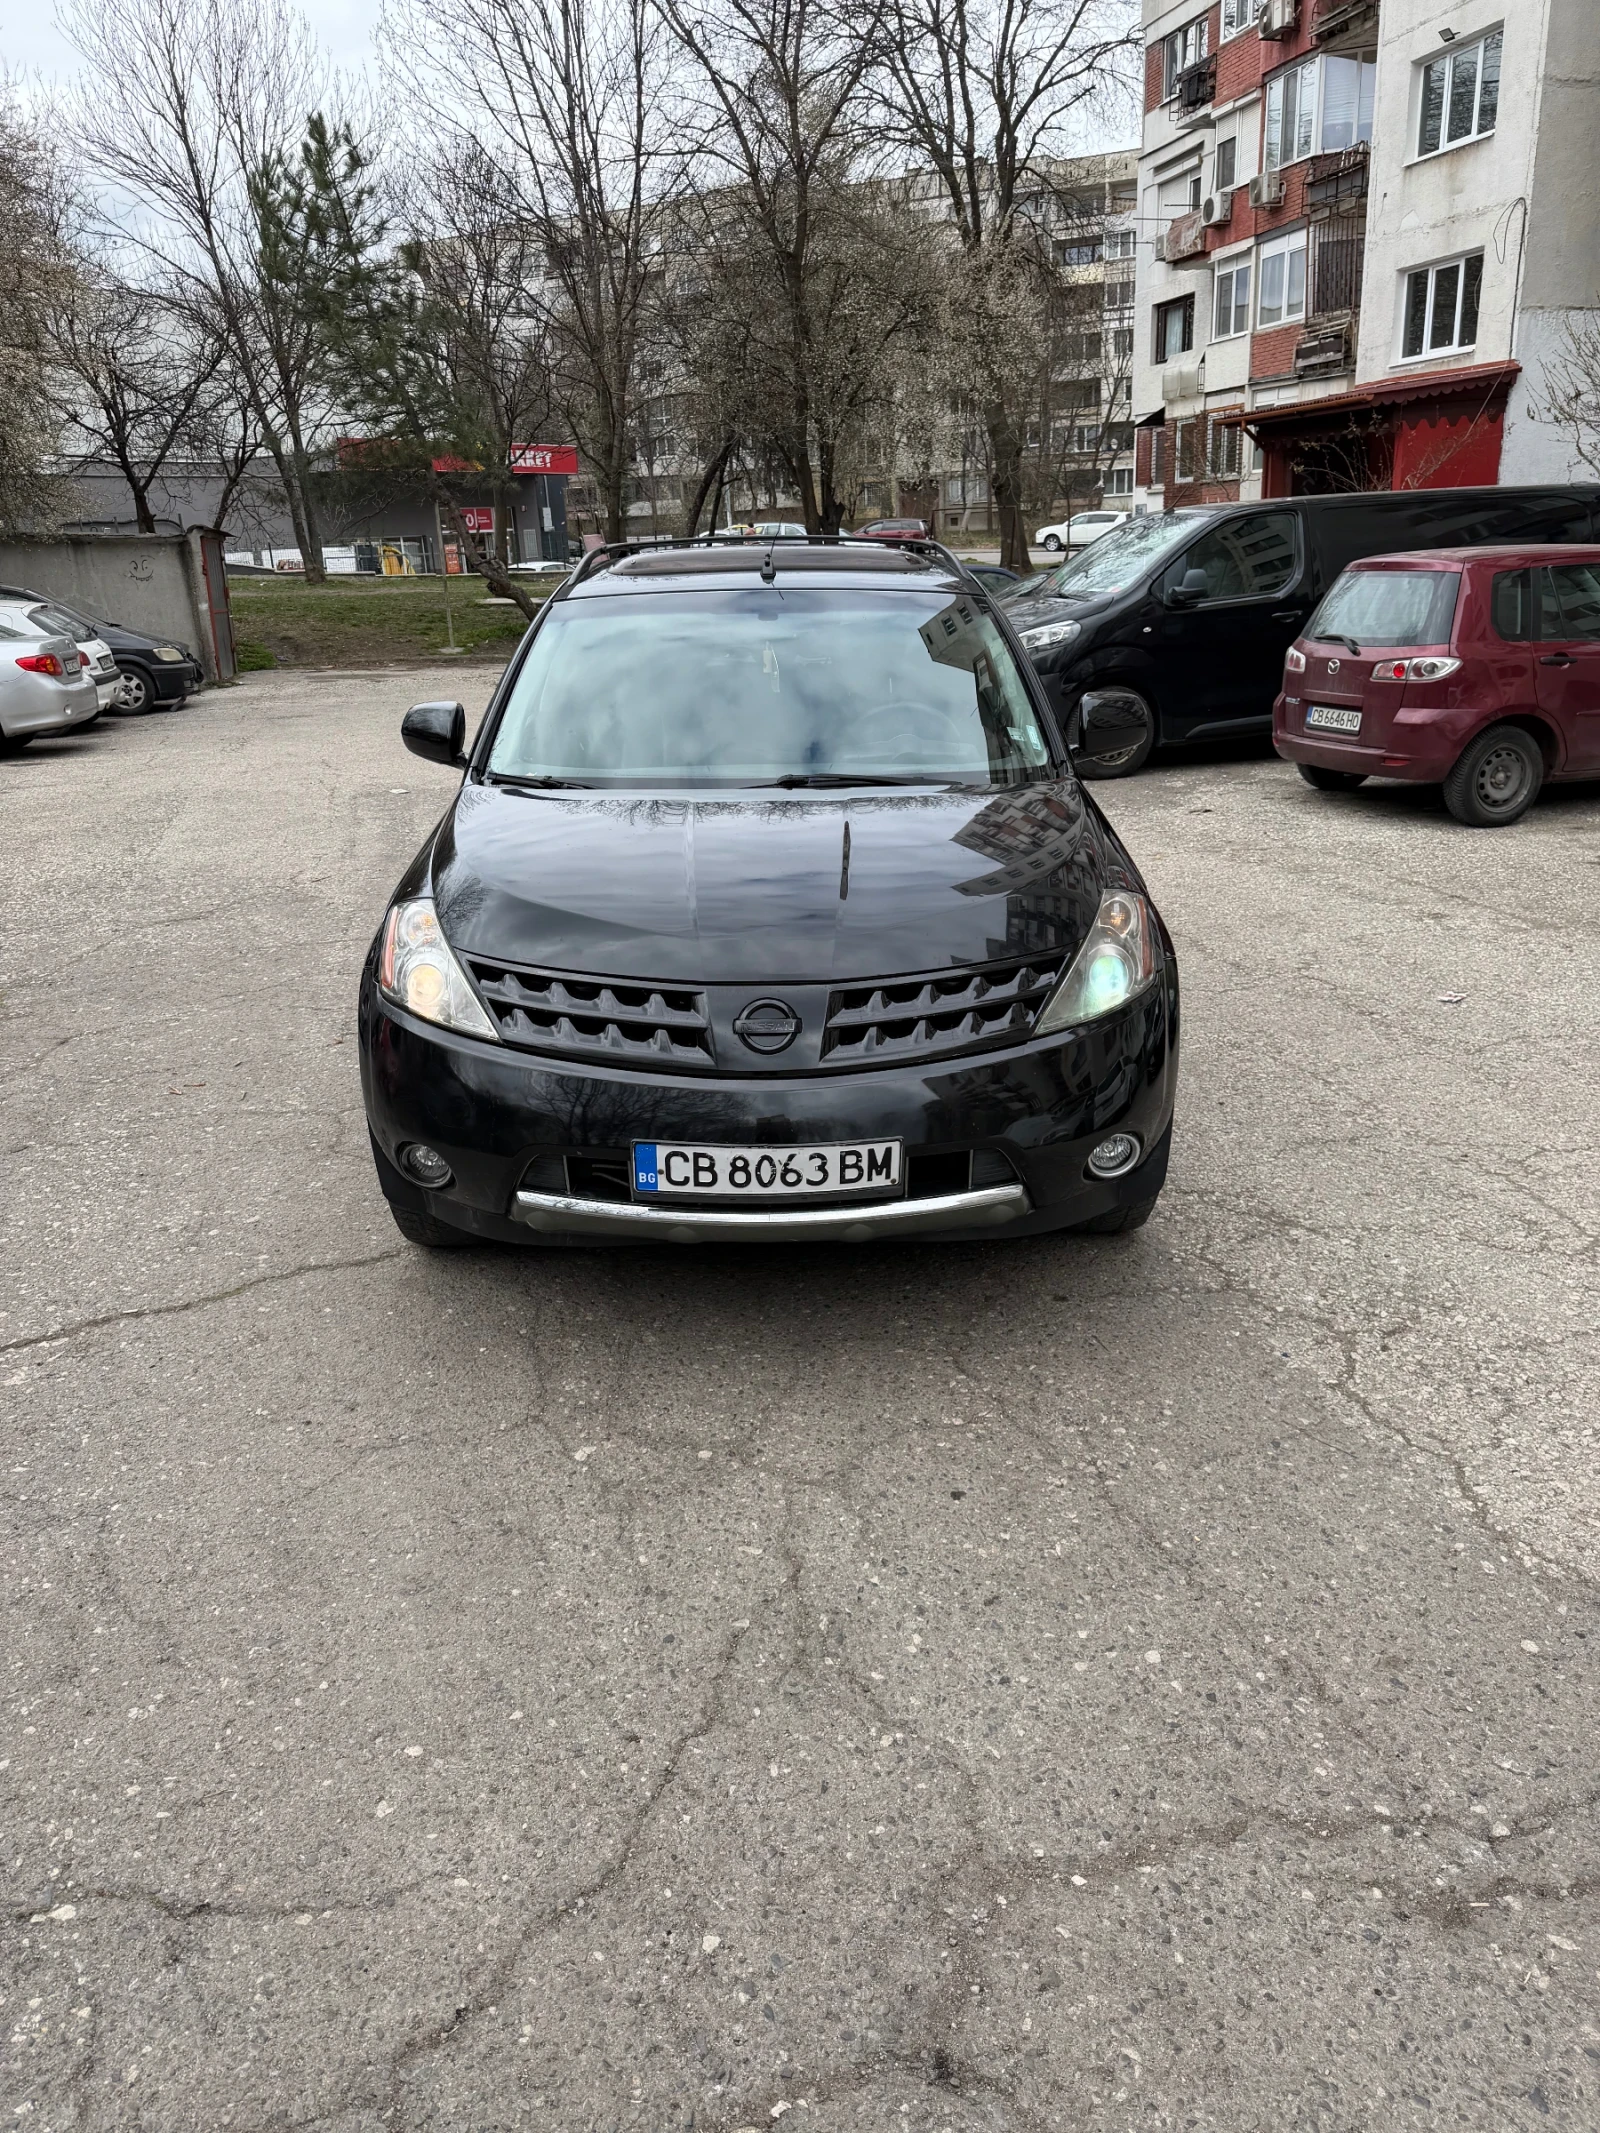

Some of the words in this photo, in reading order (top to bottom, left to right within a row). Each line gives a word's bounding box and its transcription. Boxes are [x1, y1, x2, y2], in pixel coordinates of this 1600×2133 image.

[1312, 709, 1324, 723] CB
[1324, 711, 1345, 726] 6646
[1346, 713, 1359, 728] HO
[740, 1021, 795, 1032] NISSAN
[664, 1150, 718, 1188] CB
[728, 1152, 830, 1188] 8063
[839, 1146, 893, 1185] BM
[638, 1172, 656, 1184] BG
